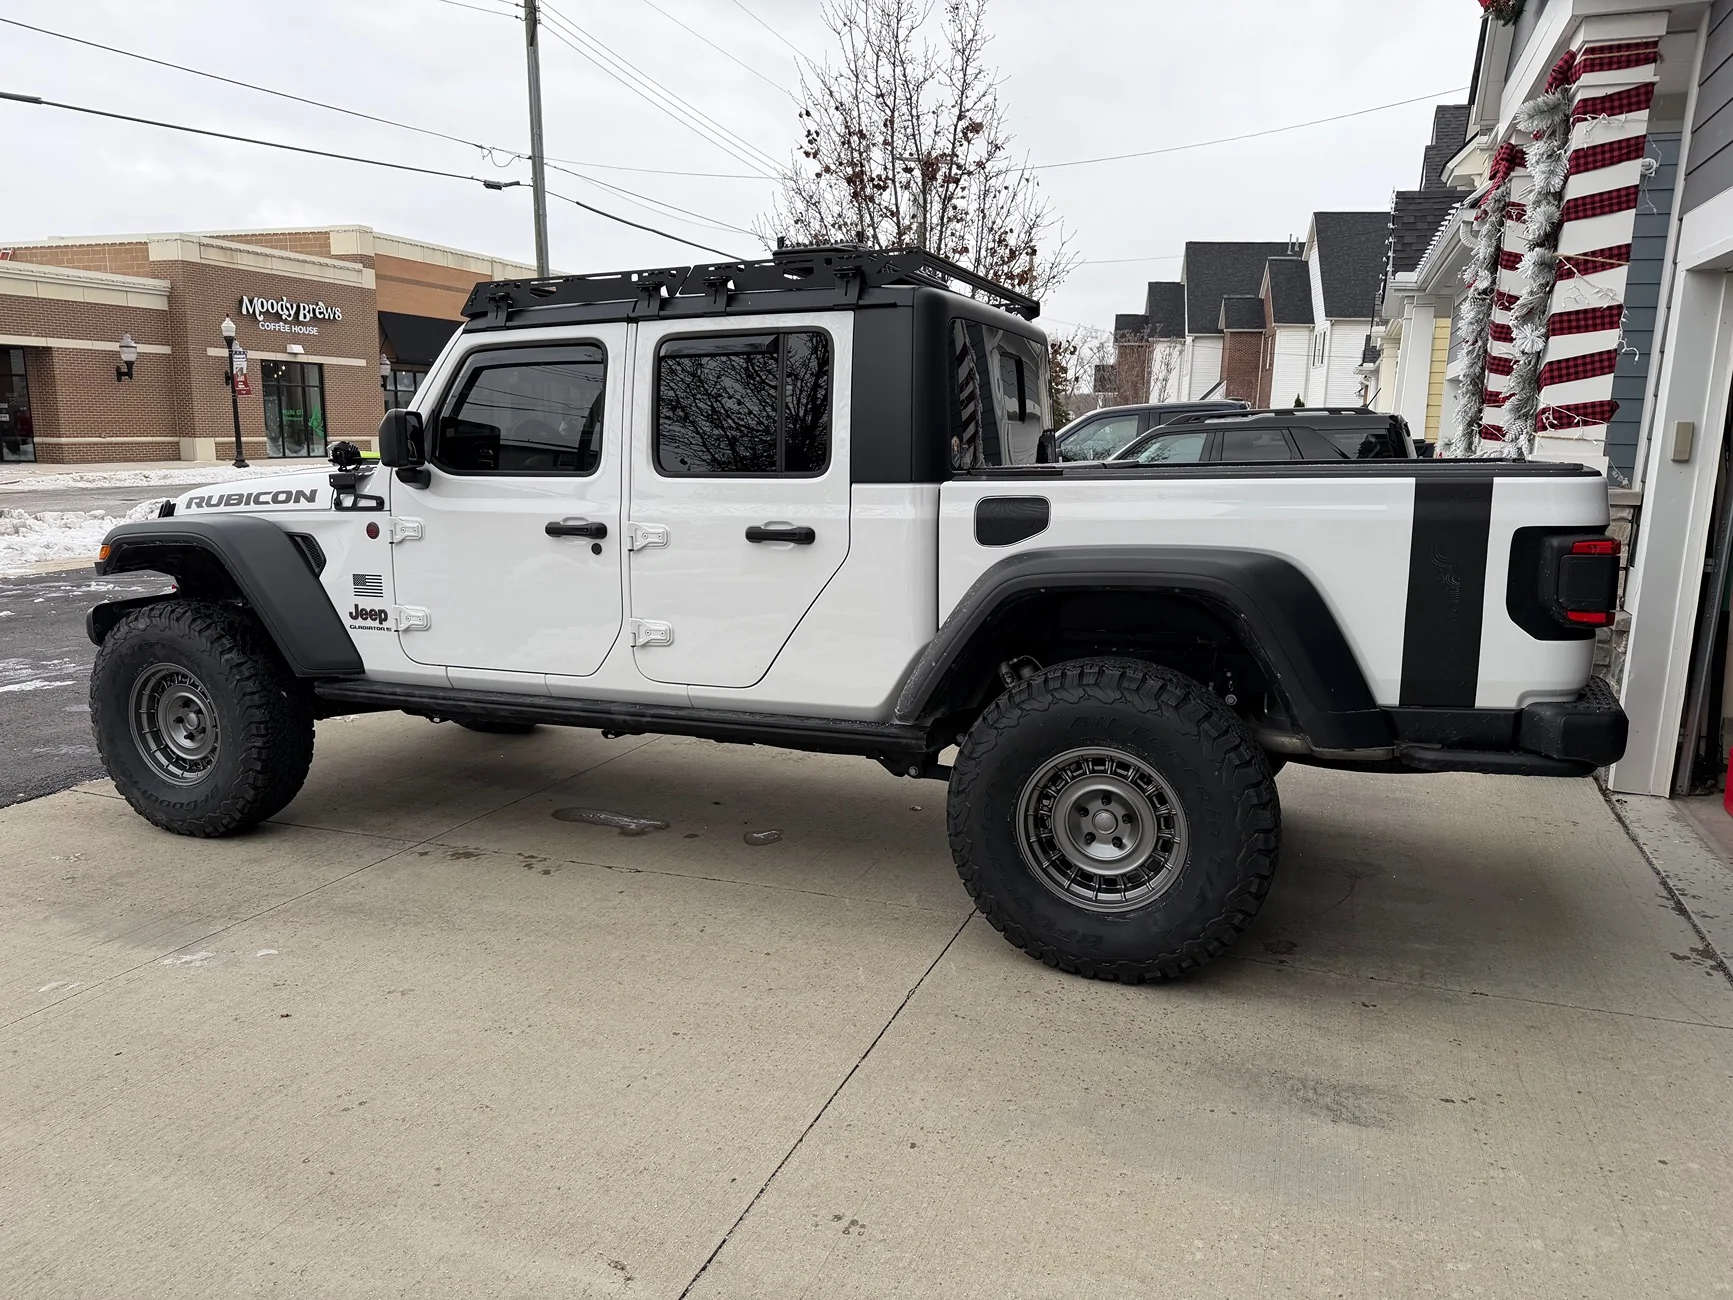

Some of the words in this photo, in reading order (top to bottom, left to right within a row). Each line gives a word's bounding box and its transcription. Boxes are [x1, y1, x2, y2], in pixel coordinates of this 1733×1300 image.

[241, 296, 296, 321] Moody
[298, 301, 342, 321] Brews
[259, 322, 290, 332] COFFEE
[291, 325, 318, 335] HOUSE
[185, 489, 318, 509] RUBICON
[349, 603, 388, 625] Jeep
[349, 624, 385, 632] GLADIATOR
